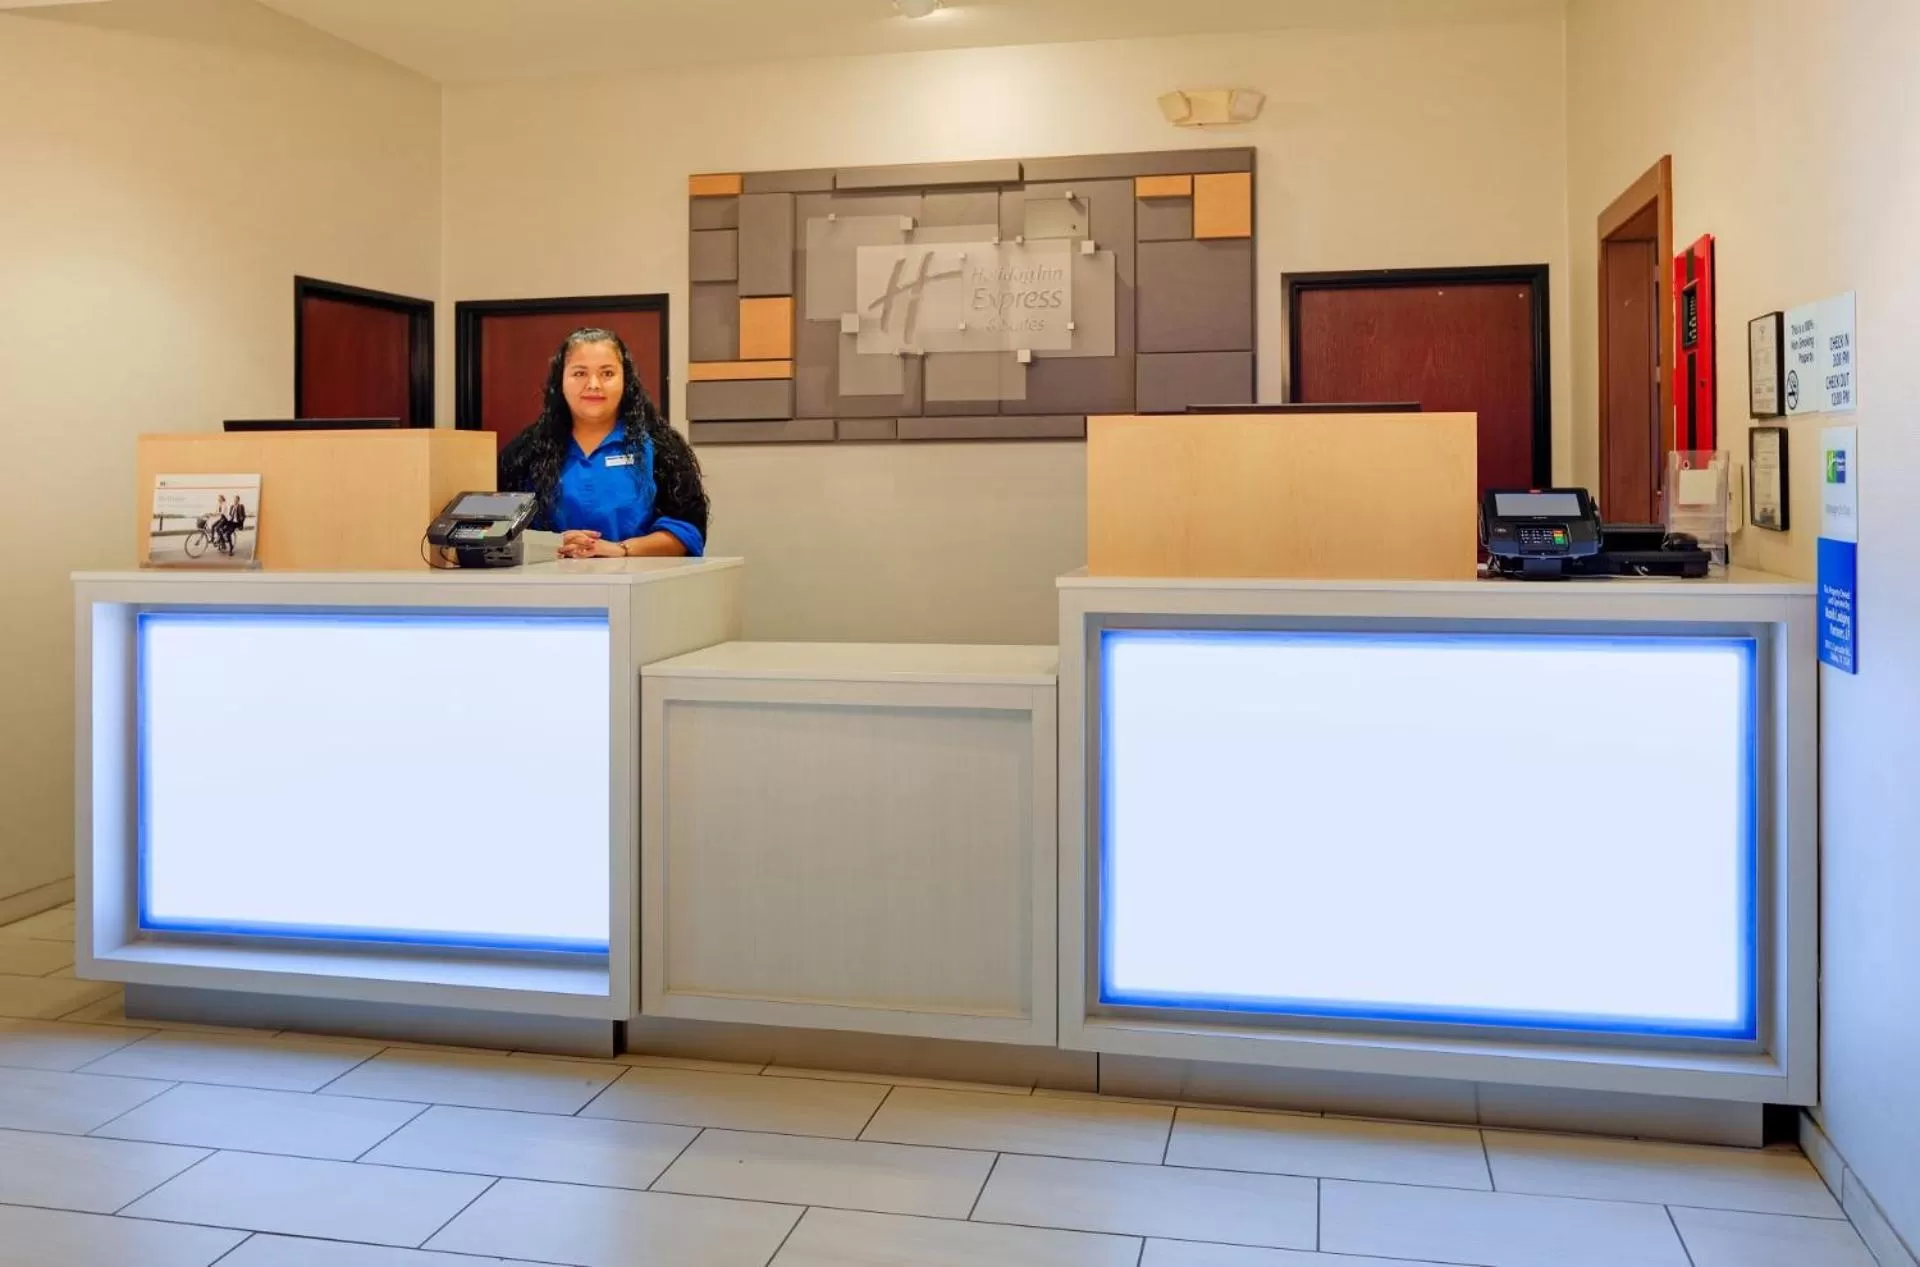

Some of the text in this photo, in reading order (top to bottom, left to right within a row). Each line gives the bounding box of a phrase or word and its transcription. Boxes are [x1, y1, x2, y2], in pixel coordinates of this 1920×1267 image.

[971, 287, 1064, 316] Express
[1829, 335, 1844, 350] CHECK
[1842, 350, 1850, 365] PM
[1825, 372, 1850, 390] CHECK OUT
[1842, 390, 1850, 404] PM
